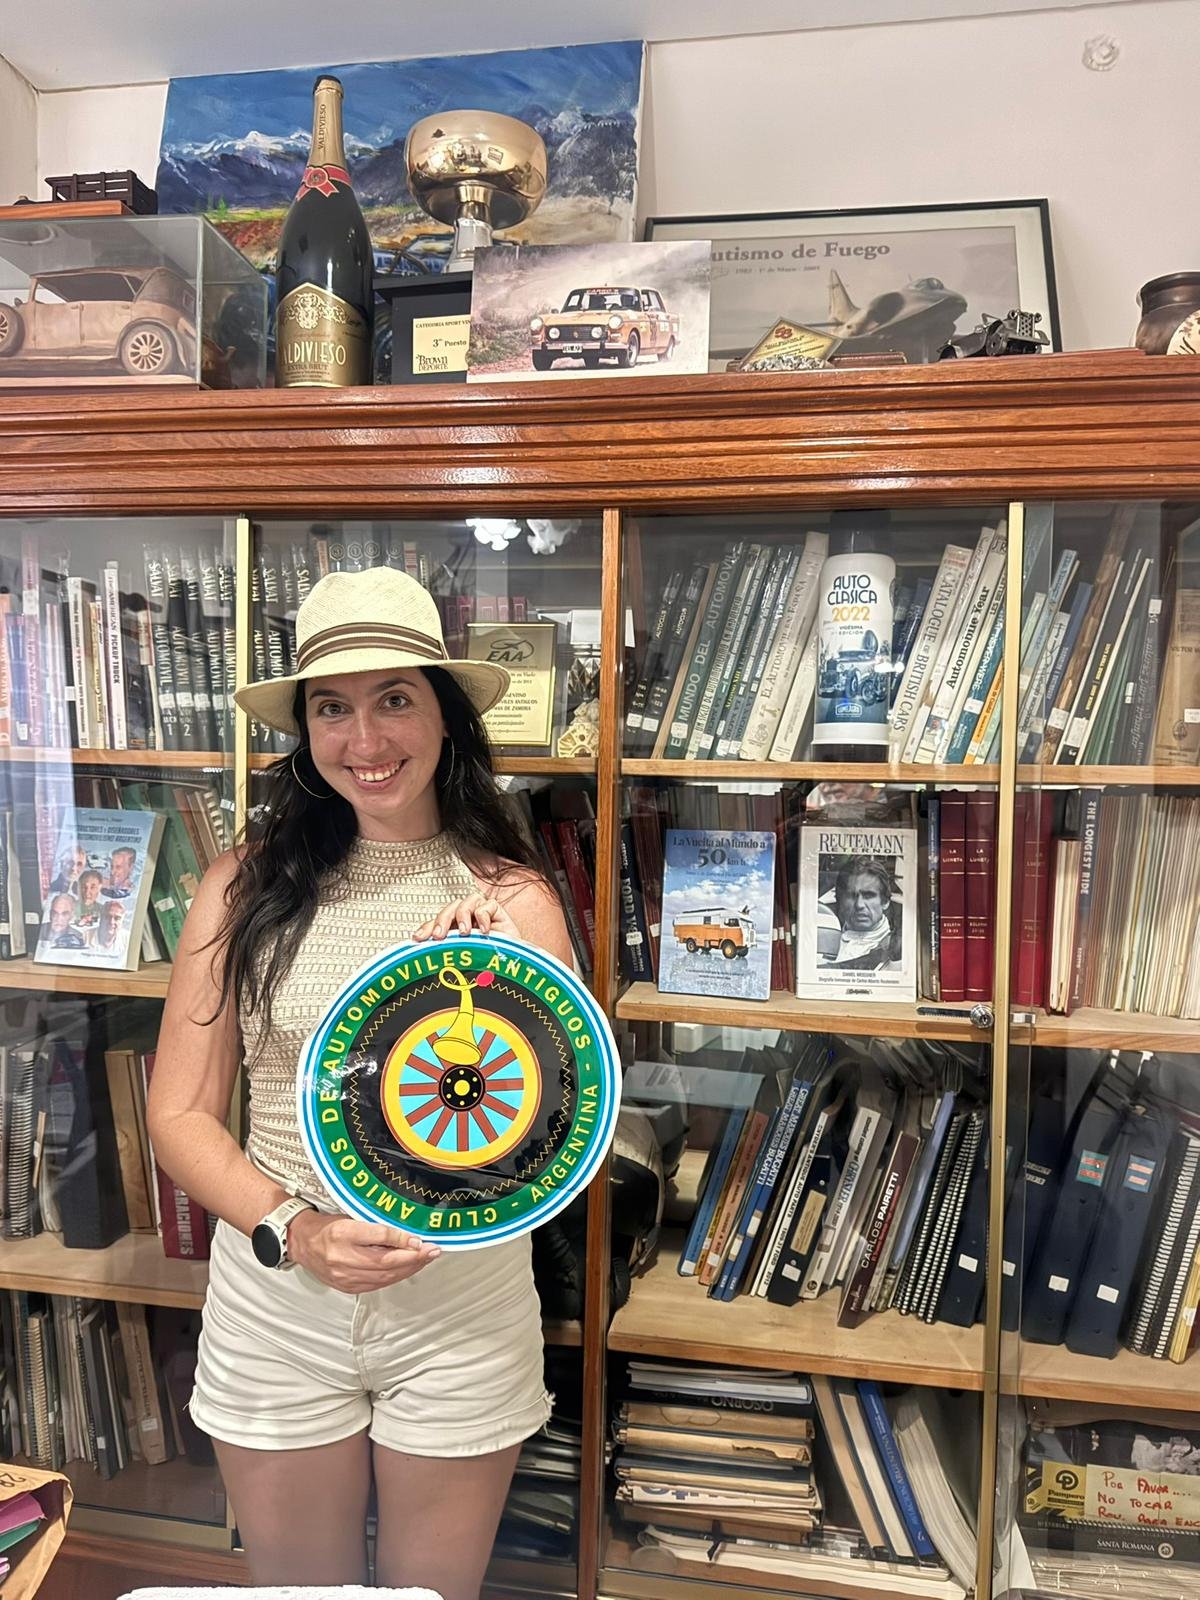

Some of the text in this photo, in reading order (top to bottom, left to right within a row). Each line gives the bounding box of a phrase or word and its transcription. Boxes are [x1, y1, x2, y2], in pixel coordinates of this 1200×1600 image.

[318, 104, 326, 149] VALDIVIESO
[711, 242, 890, 262] utismo de Fuego
[827, 590, 878, 606] CLASICA
[834, 574, 870, 590] AUTO
[832, 606, 870, 622] 2022
[923, 571, 953, 644] CATALOGUE
[111, 634, 119, 662] PICKUP
[678, 546, 740, 722] MUNDO DEL AUTOMOVIL
[947, 614, 980, 690] Automobile
[972, 586, 990, 614] Year
[154, 625, 172, 686] AUTOMOVIL
[208, 628, 224, 690] AUTOMOVIL
[486, 650, 524, 662] EAA
[905, 653, 930, 702] BRITISH
[184, 724, 191, 736] 2
[893, 699, 913, 737] CARS
[263, 728, 270, 742] 7
[673, 837, 686, 848] La
[686, 837, 716, 848] Vuelta
[716, 838, 726, 849] al
[726, 838, 760, 849] Mundo
[698, 849, 726, 868] 50
[820, 833, 904, 854] REUTEMANN
[1080, 801, 1097, 895] THE LONGEST RIDE
[622, 878, 635, 914] FORD
[322, 950, 474, 1073] AUTOMOVILES
[486, 954, 592, 1050] ANTIGUOS
[320, 1090, 339, 1124] DE
[530, 1082, 599, 1204] ARGENTINA
[330, 1137, 416, 1221] AMIGOS
[757, 1148, 775, 1185] BUGATTI
[765, 1149, 784, 1187] BUGATTI
[801, 1153, 814, 1183] ANTIQUE
[795, 1182, 805, 1200] AUTO
[842, 1161, 860, 1205] CHRYSLER
[429, 1209, 497, 1228] CLUB
[787, 1197, 798, 1218] PARTS
[861, 1221, 883, 1268] CARLOS
[876, 1171, 899, 1221] PAIRETTI
[770, 1247, 781, 1268] FORD
[1048, 1489, 1085, 1500] Pampero
[1097, 1492, 1116, 1505] NO
[1130, 1498, 1173, 1510] TOCAR
[1096, 1539, 1155, 1552] SANTA ROMANA
